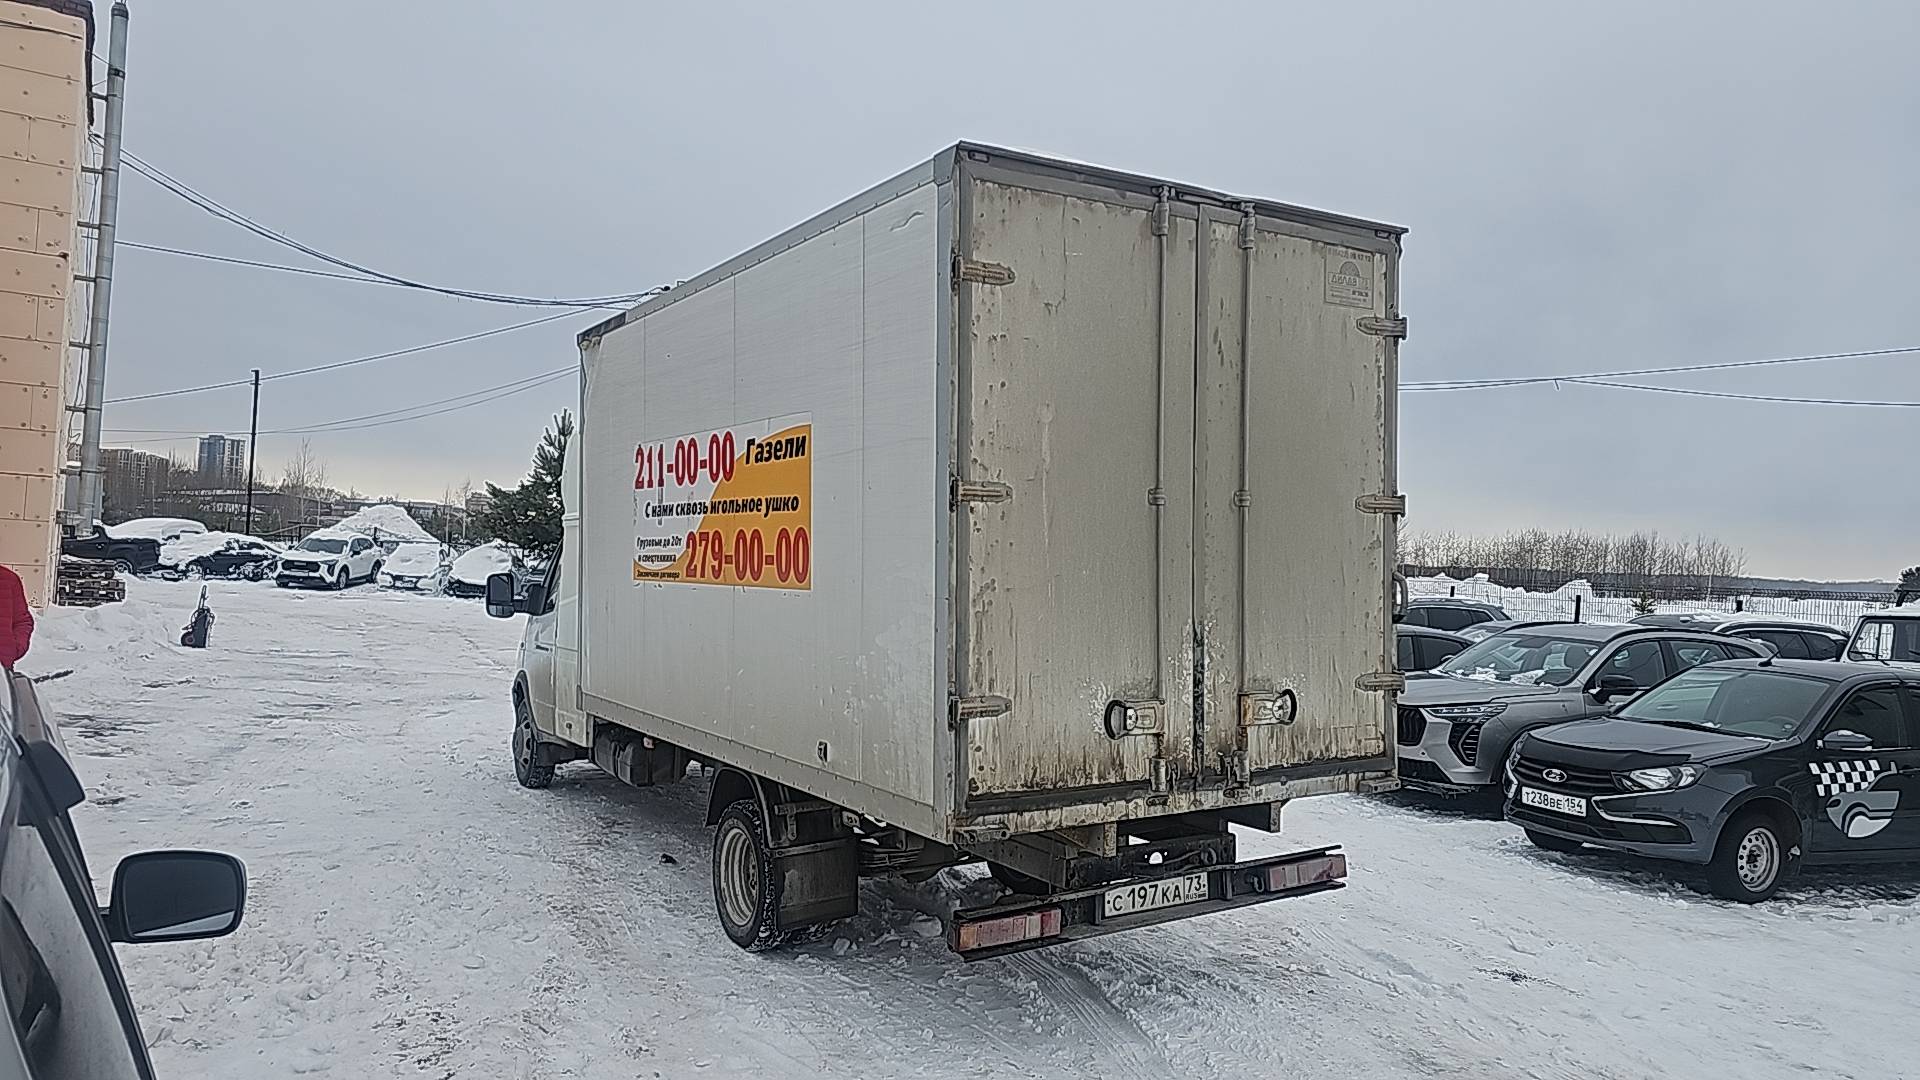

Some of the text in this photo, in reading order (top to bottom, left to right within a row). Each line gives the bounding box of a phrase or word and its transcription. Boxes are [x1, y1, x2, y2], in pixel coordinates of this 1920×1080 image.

[634, 430, 735, 489] 211-00-00
[745, 435, 807, 465] Газели
[645, 495, 800, 518] С нами сквозь игольное ушко
[636, 536, 662, 550] Грузовые
[662, 538, 671, 549] до
[642, 554, 677, 565] спецтехника
[685, 526, 810, 584] 279-00-00
[1564, 797, 1583, 811] 154
[1185, 875, 1202, 894] 73
[1185, 892, 1198, 901] RUS
